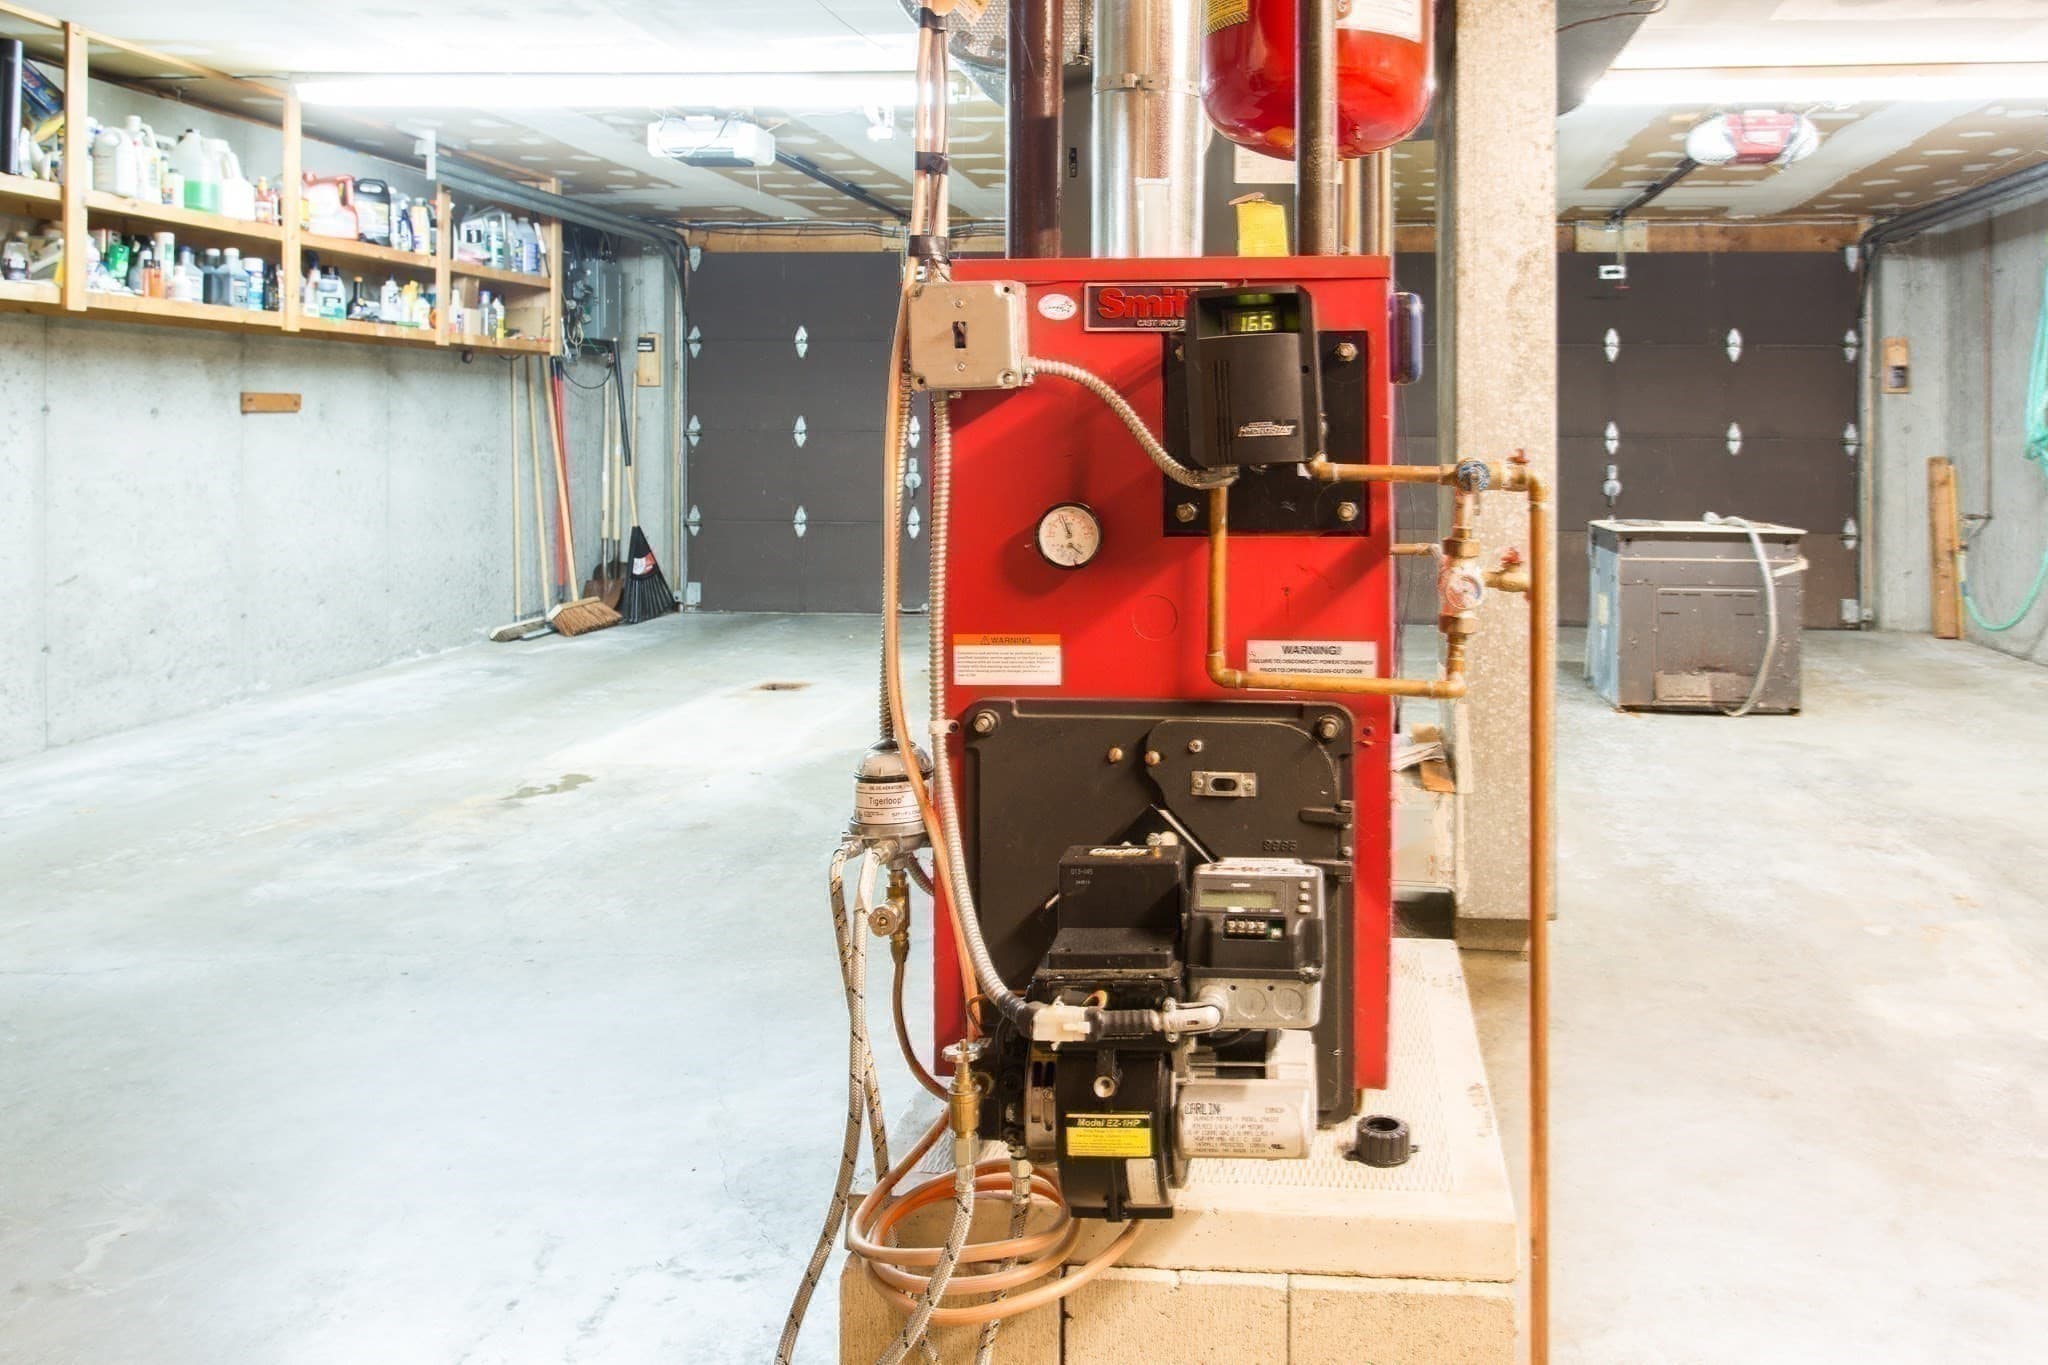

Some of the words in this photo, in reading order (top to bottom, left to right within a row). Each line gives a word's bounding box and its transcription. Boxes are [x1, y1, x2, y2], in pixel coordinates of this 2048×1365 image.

[1098, 287, 1196, 318] Smit
[1136, 319, 1157, 327] CAST
[1159, 319, 1180, 327] IRON
[1240, 314, 1274, 332] 166
[990, 636, 1032, 644] WARNING
[869, 796, 902, 807] Tigerloop
[1184, 1102, 1221, 1115] CARLIN
[1077, 1118, 1104, 1127] Model
[1106, 1119, 1142, 1127] EZ-1HP
